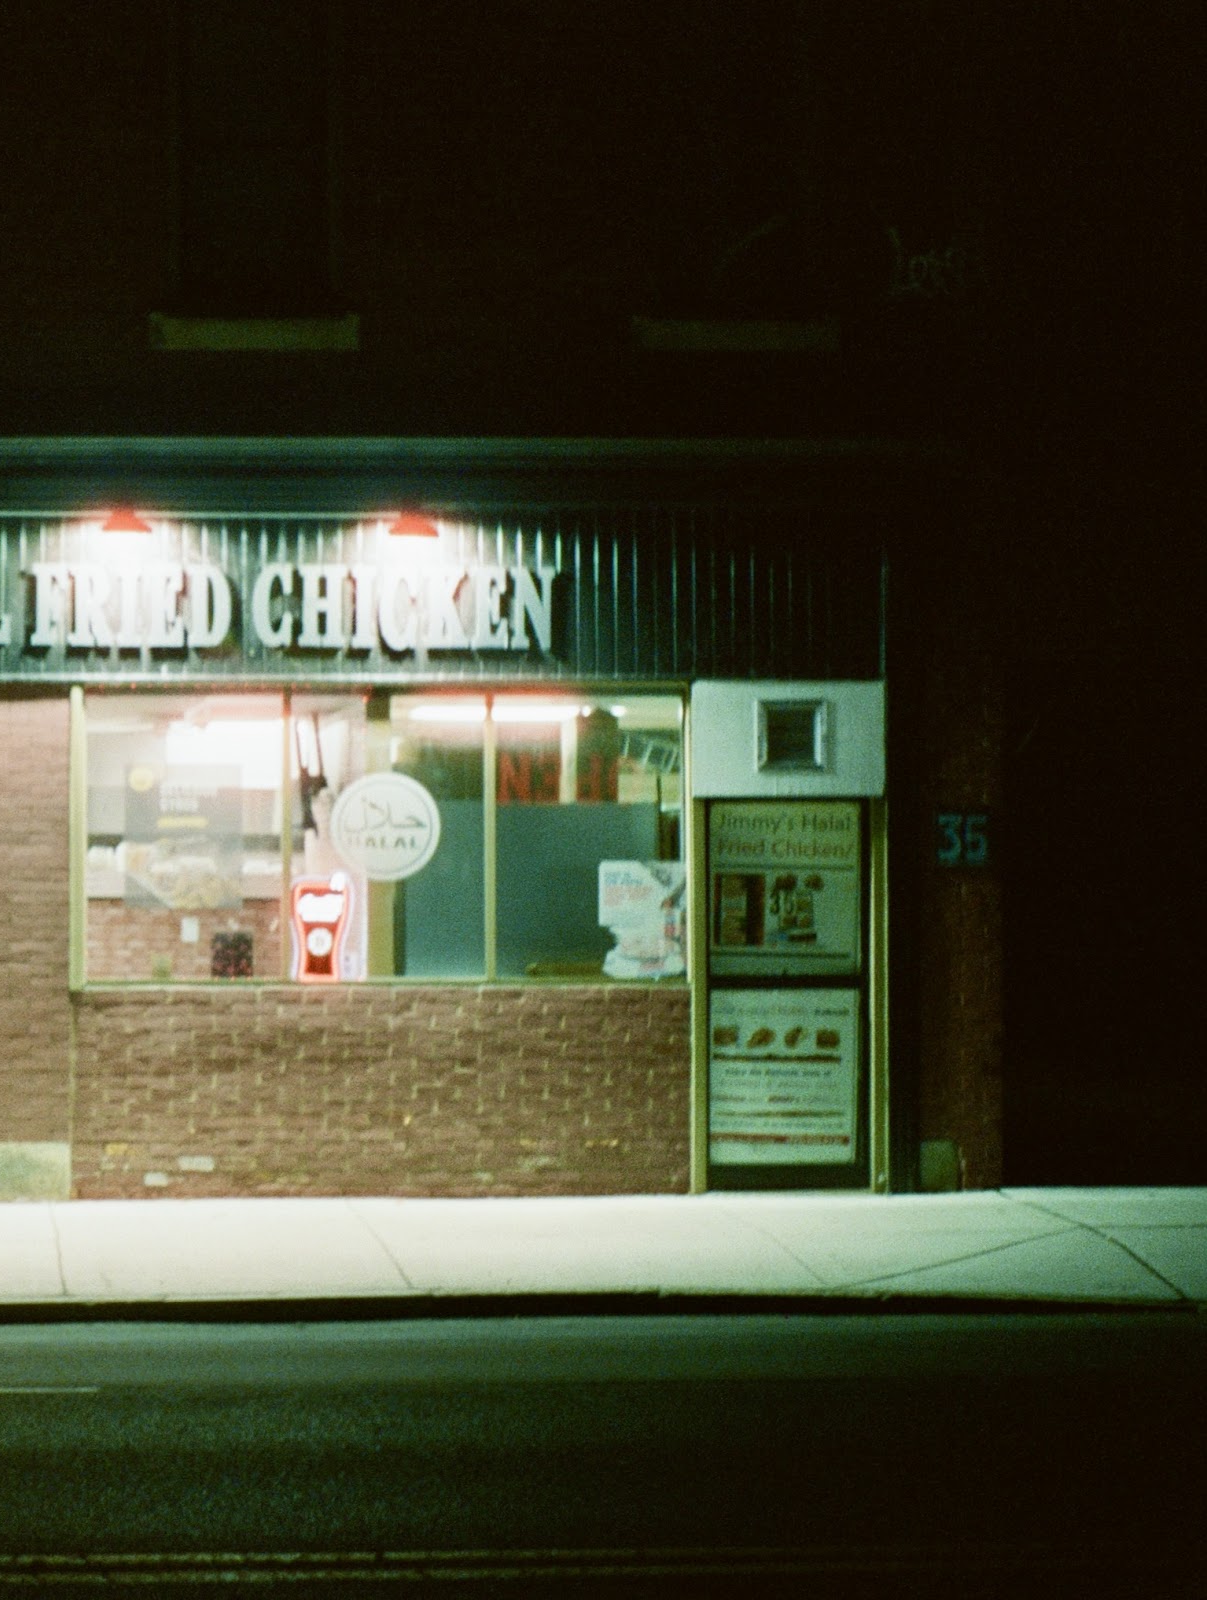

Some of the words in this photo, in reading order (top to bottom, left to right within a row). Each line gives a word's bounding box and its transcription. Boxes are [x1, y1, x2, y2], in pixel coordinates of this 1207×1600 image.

[30, 560, 234, 650] FRIED
[252, 562, 555, 652] CHICKEN
[717, 812, 793, 834] Jimmy's
[801, 813, 852, 832] Halal
[937, 814, 990, 869] 35
[717, 838, 766, 856] Fried
